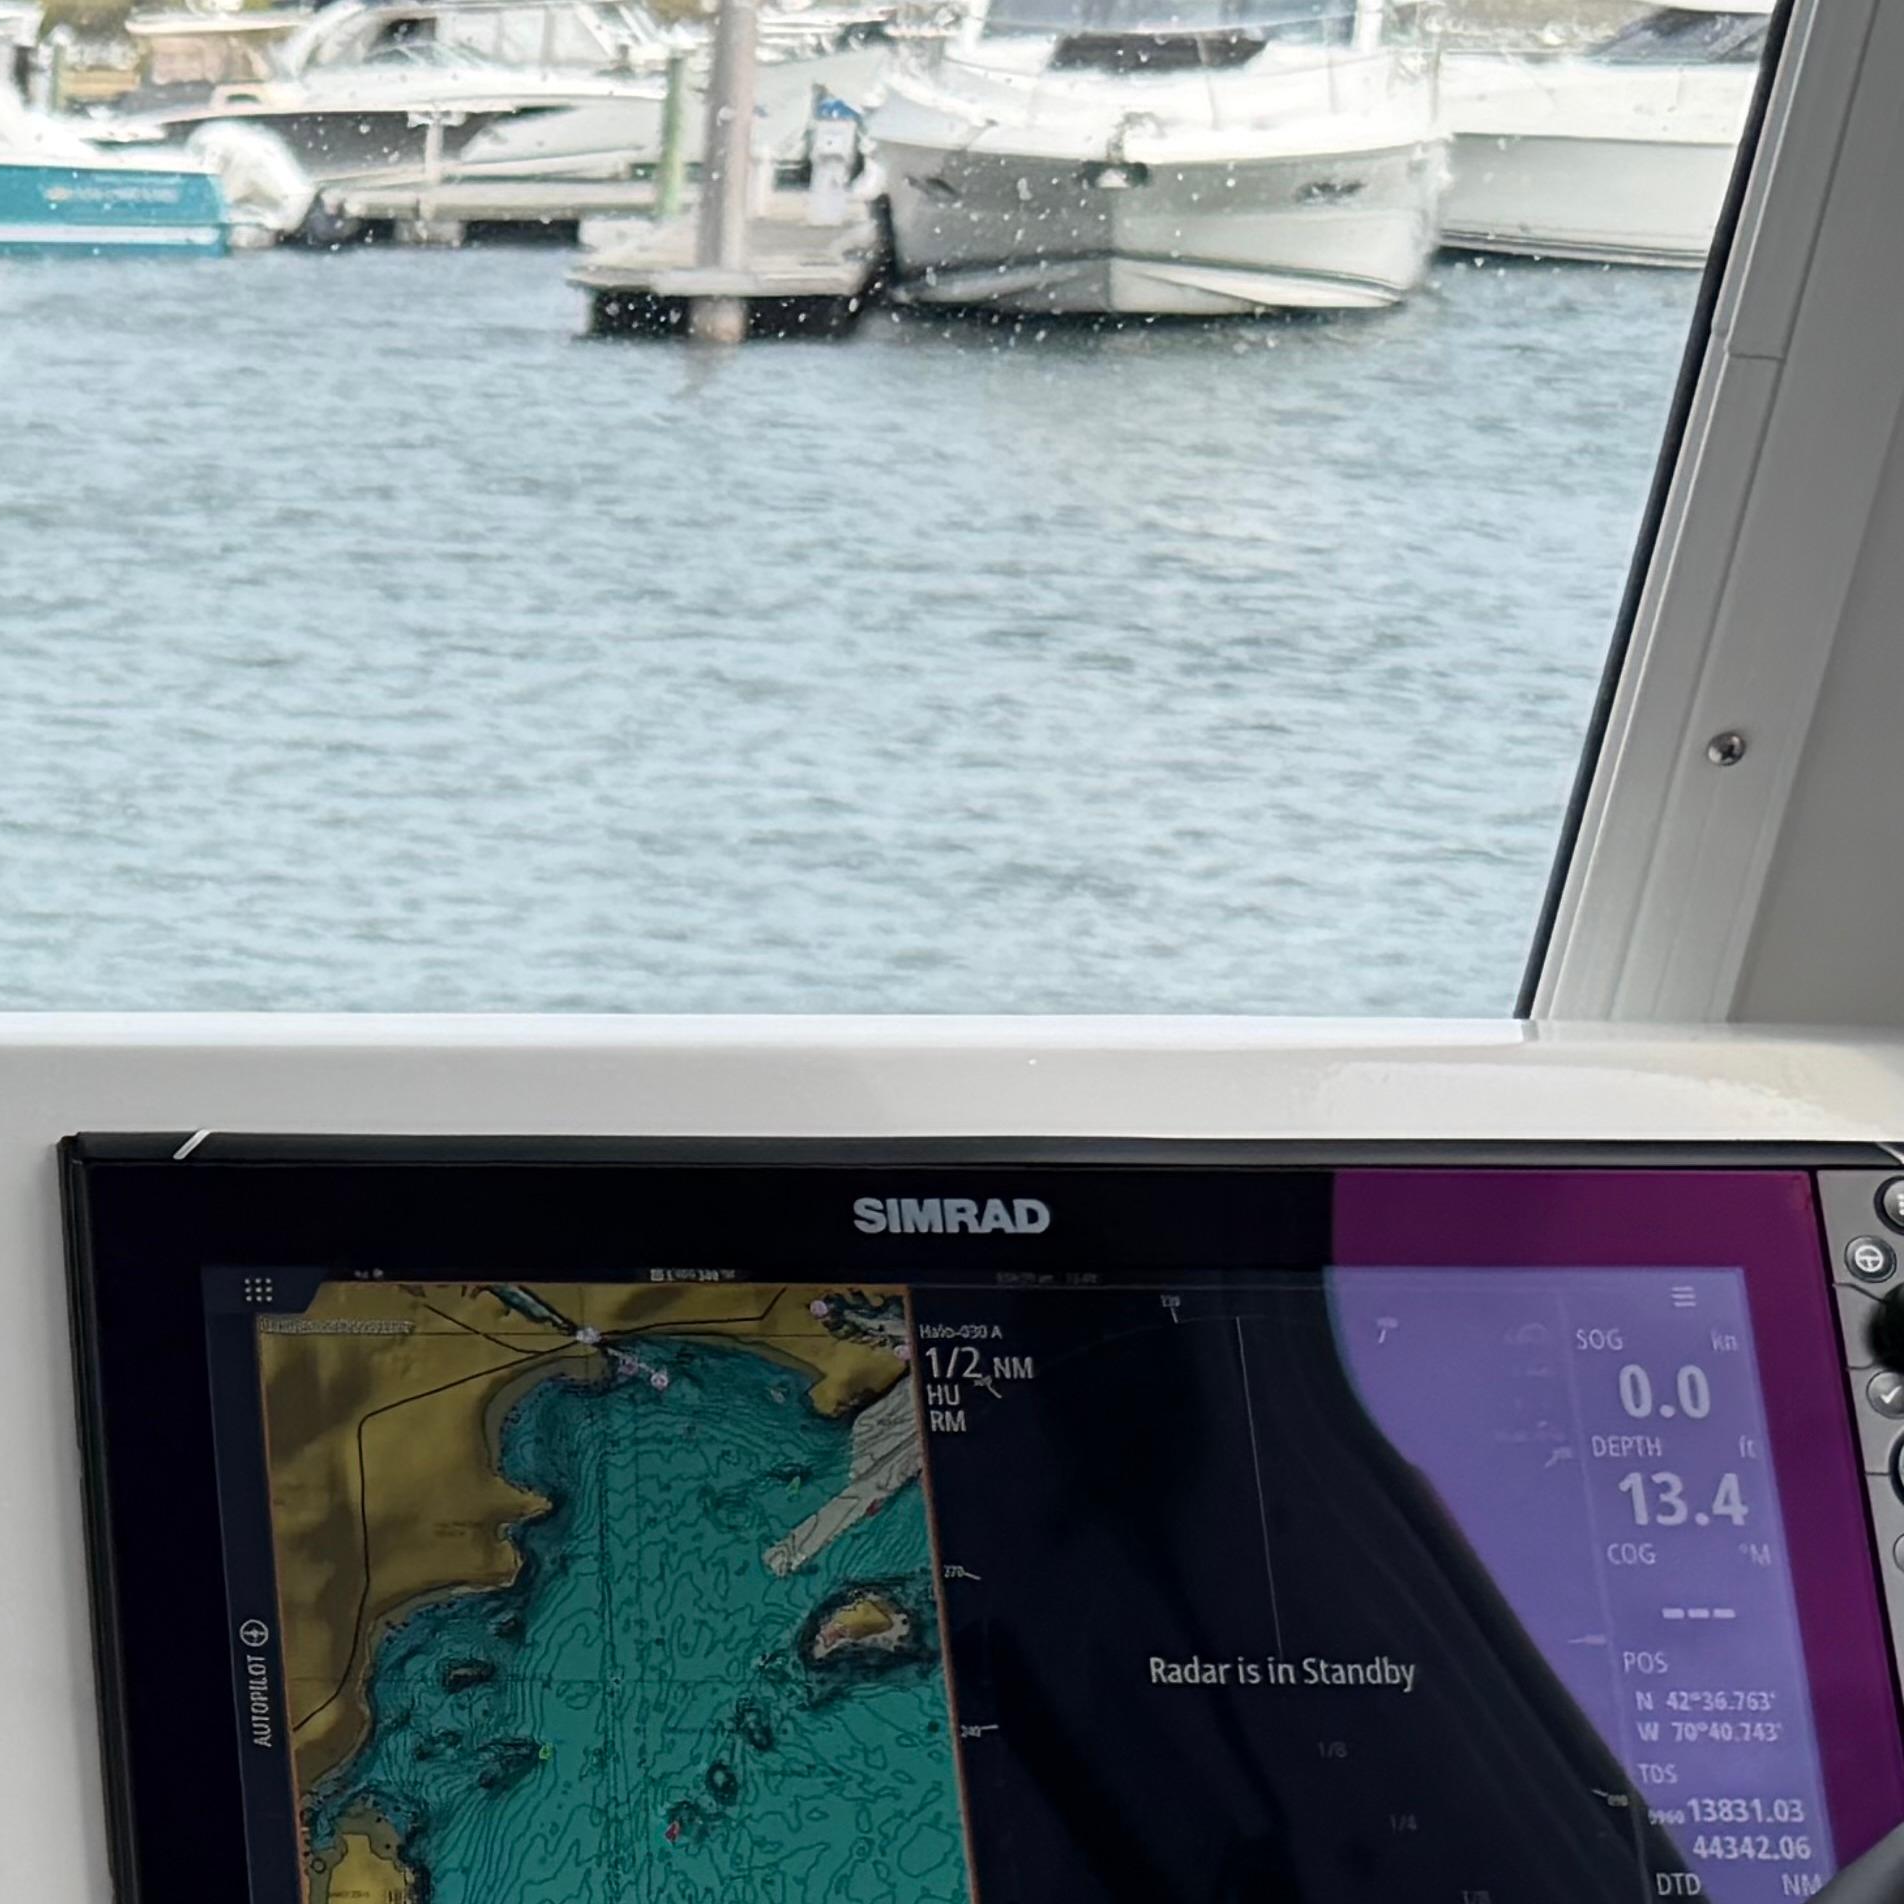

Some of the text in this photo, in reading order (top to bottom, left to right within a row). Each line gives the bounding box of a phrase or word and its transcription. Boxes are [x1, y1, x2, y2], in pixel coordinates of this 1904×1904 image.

[853, 1197, 1050, 1235] SIMRAD
[1576, 1329, 1738, 1351] SOG kn
[925, 1346, 1034, 1380] 1/2 NM
[926, 1384, 961, 1406] HU
[1619, 1364, 1711, 1419] 0.0
[930, 1410, 967, 1433] RM
[1592, 1435, 1758, 1459] DEPTH ft
[1618, 1472, 1749, 1527] 13.4
[1607, 1543, 1657, 1566] COG
[1150, 1656, 1416, 1693] Radar is in Standby
[1624, 1651, 1669, 1674] POS
[252, 1654, 273, 1748] AUTOPILOT
[1636, 1691, 1654, 1711] N
[1637, 1723, 1660, 1742] W
[1638, 1763, 1679, 1784] TDS
[1687, 1797, 1805, 1824] 13831.03
[1693, 1834, 1812, 1860] 44342.06
[1656, 1872, 1821, 1897] DTD NM
